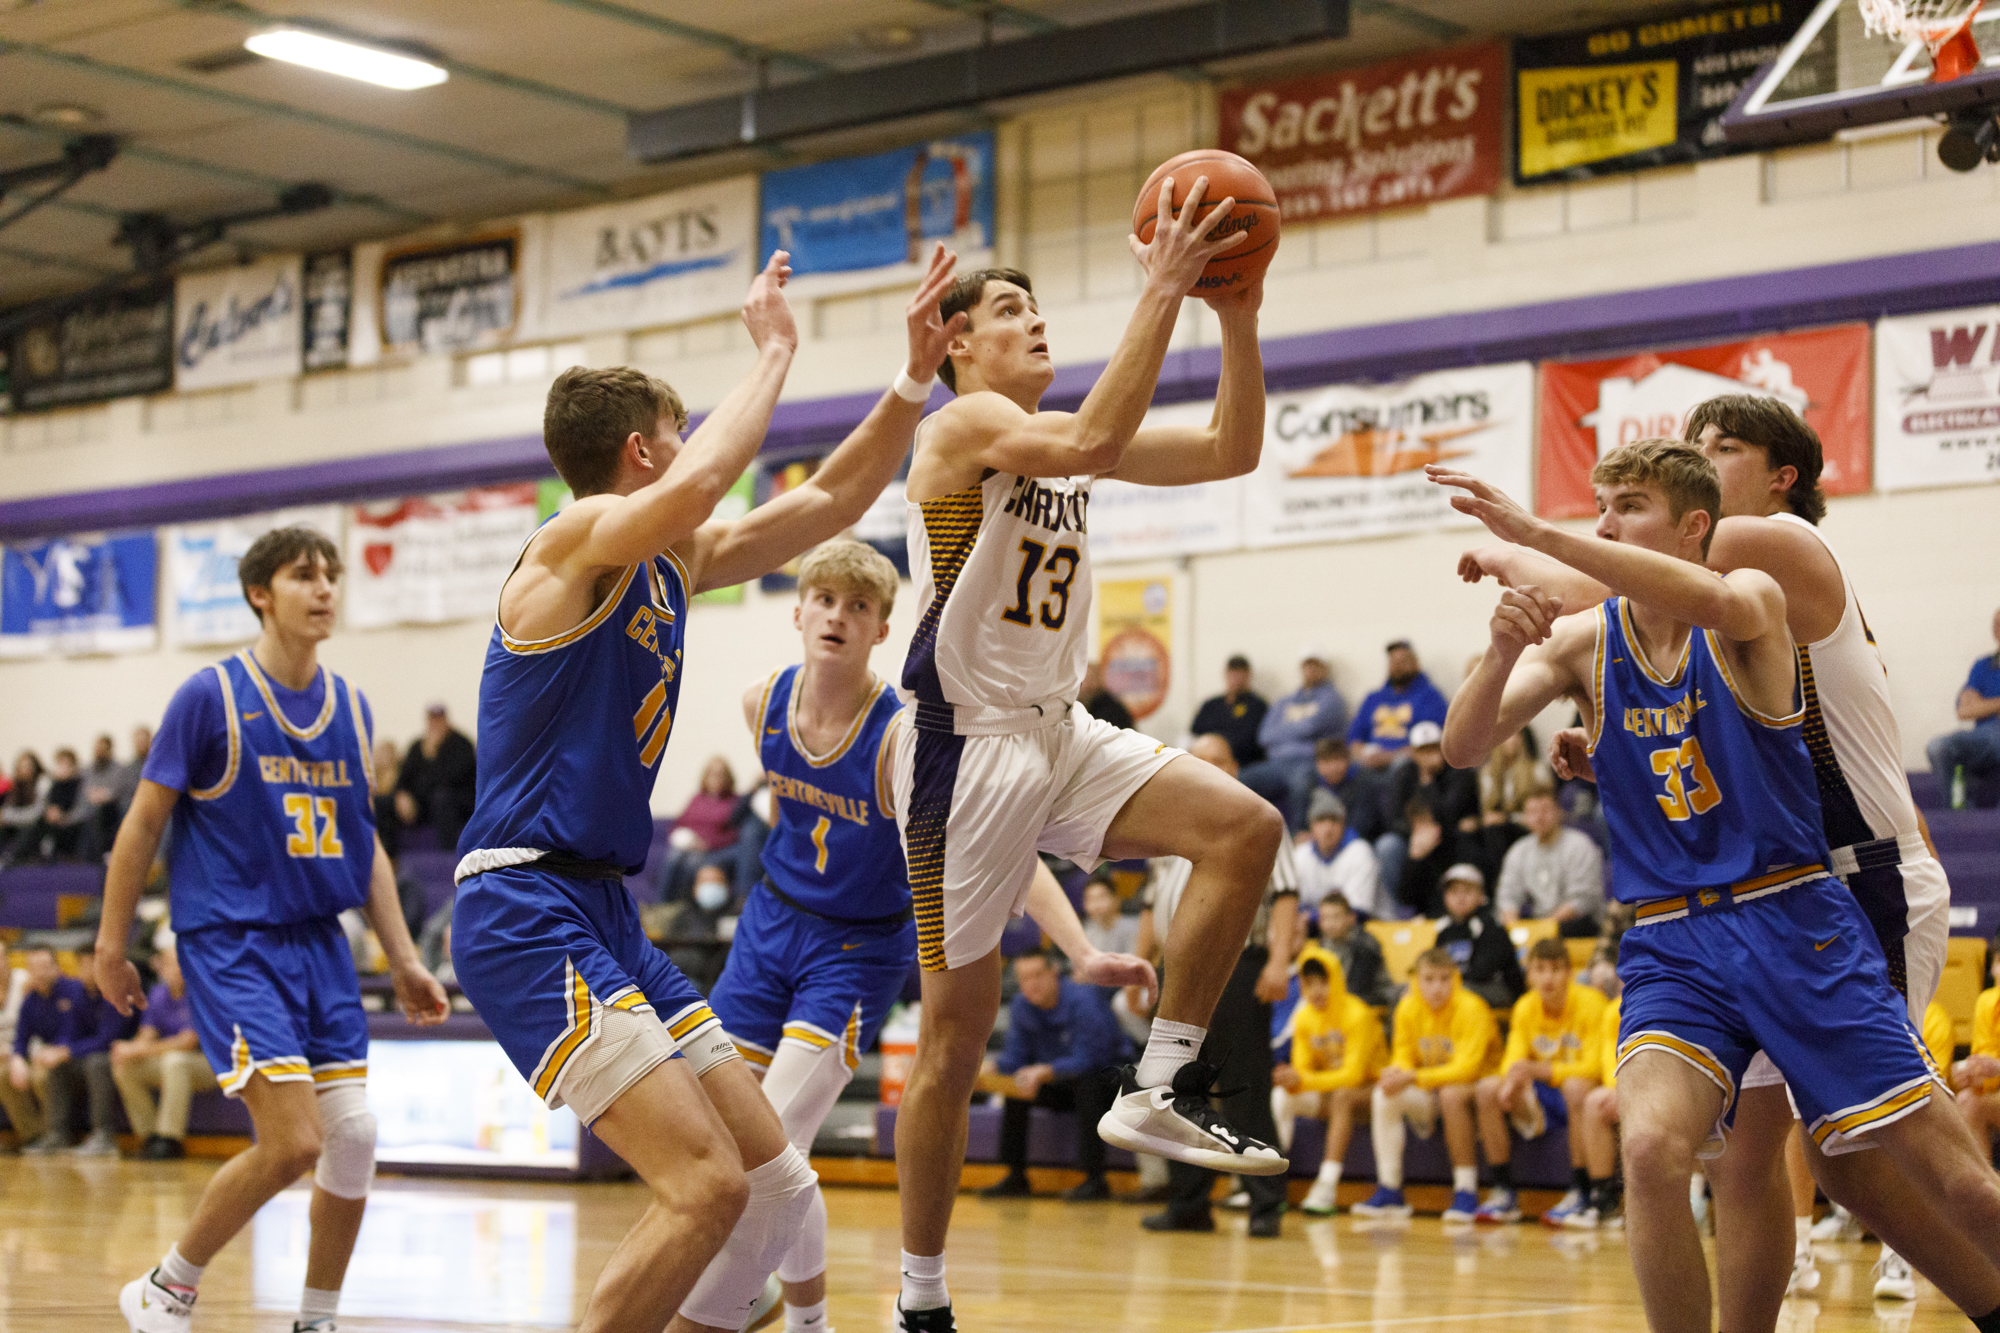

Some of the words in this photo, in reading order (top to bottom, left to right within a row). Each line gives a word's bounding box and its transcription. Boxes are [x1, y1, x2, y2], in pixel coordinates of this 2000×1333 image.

[1238, 66, 1483, 154] Sackett's
[1536, 70, 1659, 125] DICKEY'S
[1276, 390, 1491, 441] Consumers
[1001, 536, 1082, 632] 13
[1650, 735, 1723, 822] 33
[282, 792, 345, 859] 32
[811, 815, 831, 875] 1
